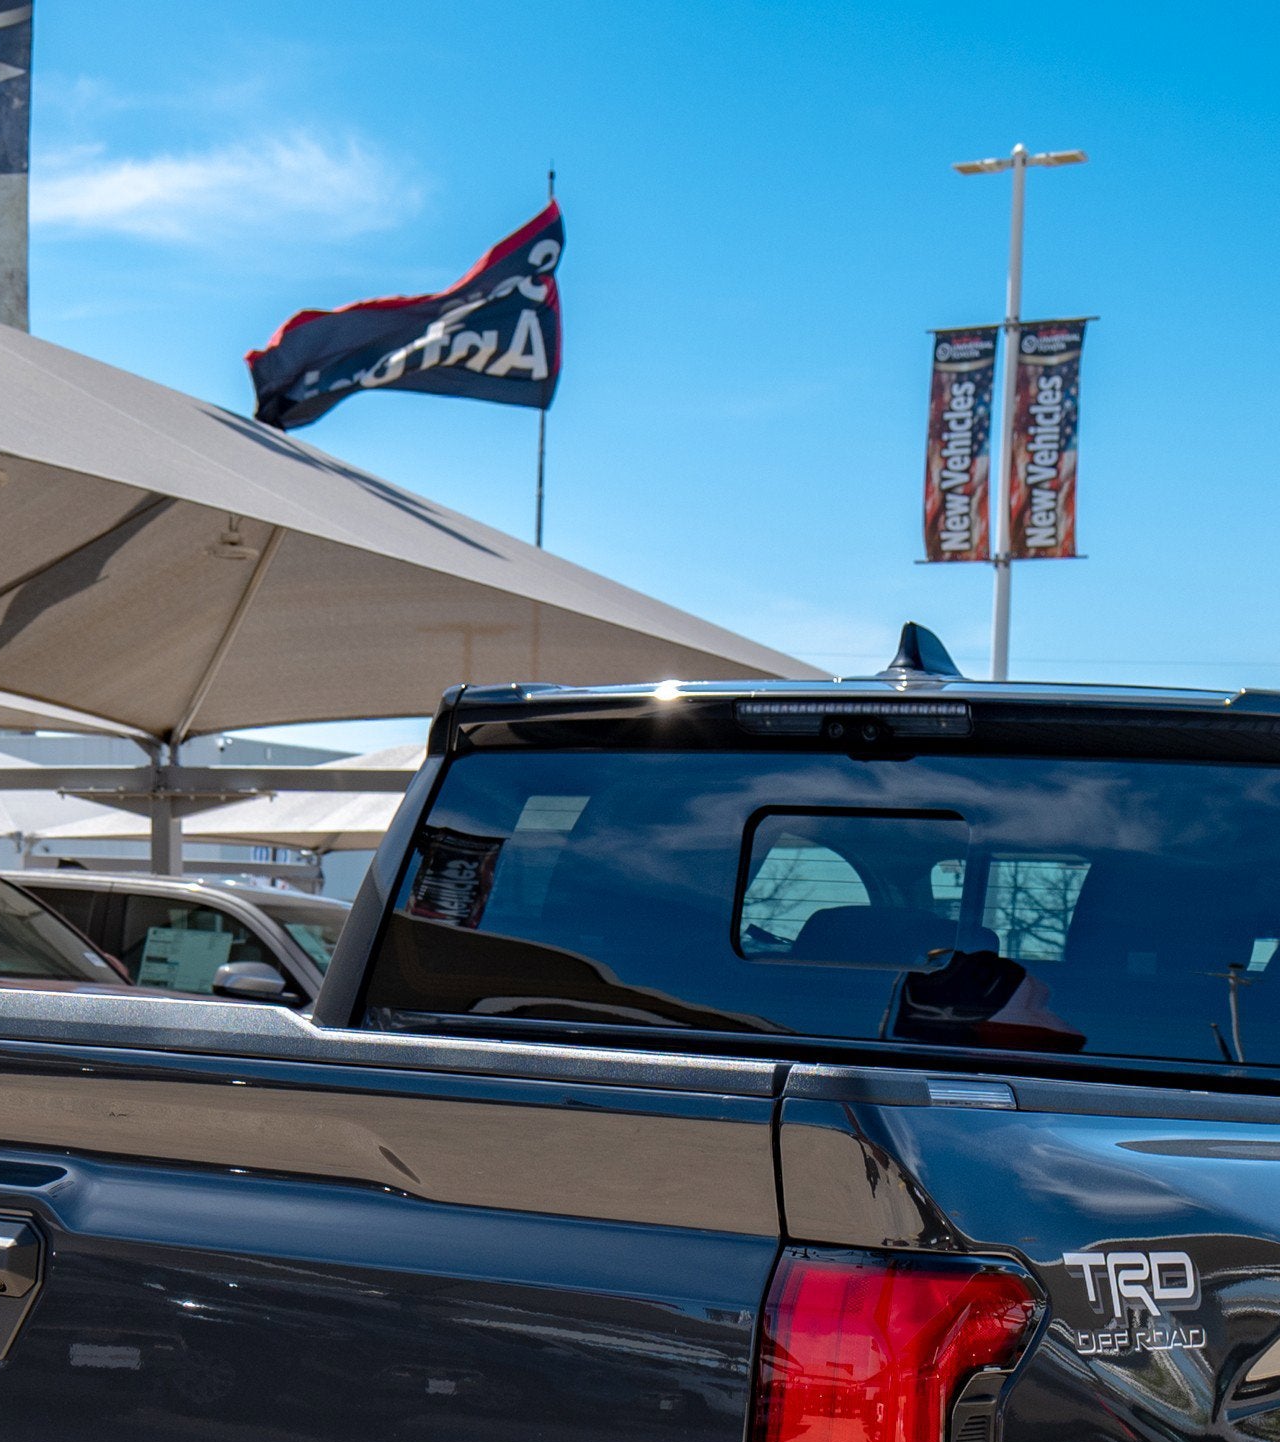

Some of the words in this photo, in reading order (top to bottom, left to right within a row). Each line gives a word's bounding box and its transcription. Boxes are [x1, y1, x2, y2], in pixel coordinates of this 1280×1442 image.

[941, 381, 976, 491] Vehicles
[1027, 375, 1063, 486] Vehicles
[940, 493, 970, 551] New
[1025, 488, 1056, 548] New
[1062, 1251, 1196, 1318] TRD
[1077, 1329, 1129, 1356] OFF
